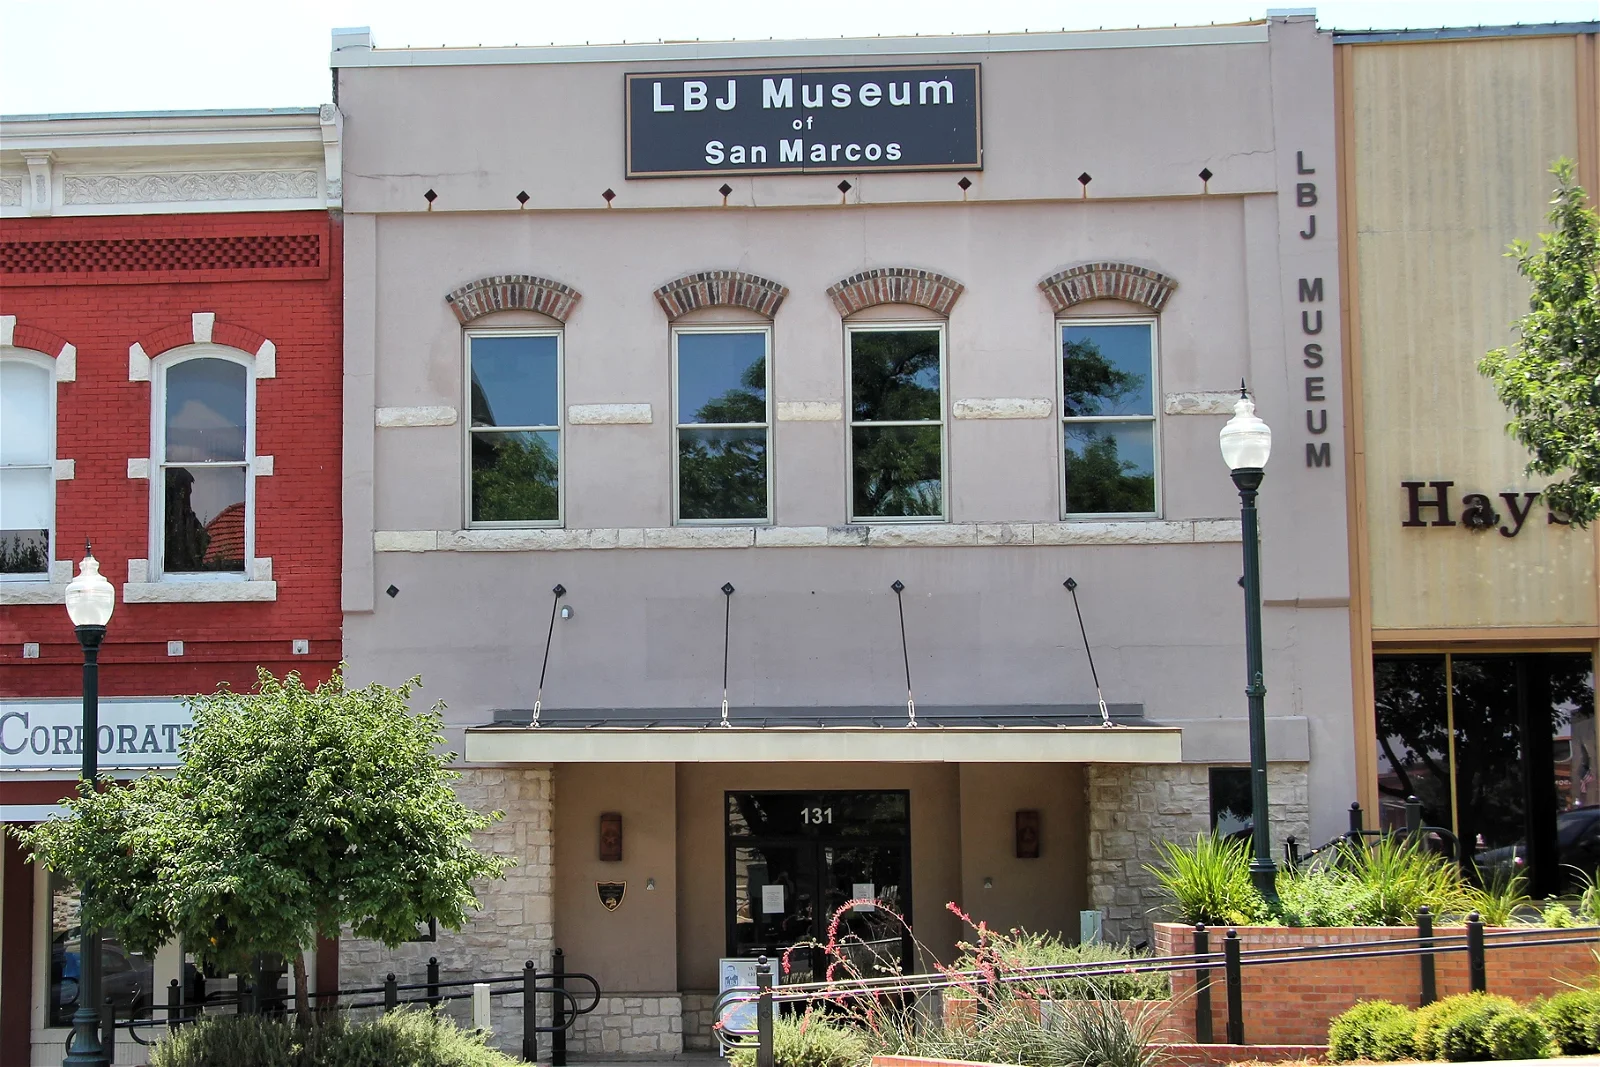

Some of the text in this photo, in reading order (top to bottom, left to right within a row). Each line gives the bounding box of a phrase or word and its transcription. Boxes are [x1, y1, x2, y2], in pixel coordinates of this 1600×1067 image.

[653, 78, 954, 112] LBJ Museum
[792, 115, 814, 130] of
[705, 139, 902, 165] San Marcos
[1296, 150, 1331, 468] LBJ MUSEUM
[0, 711, 193, 756] CORORAT
[800, 807, 833, 825] 131
